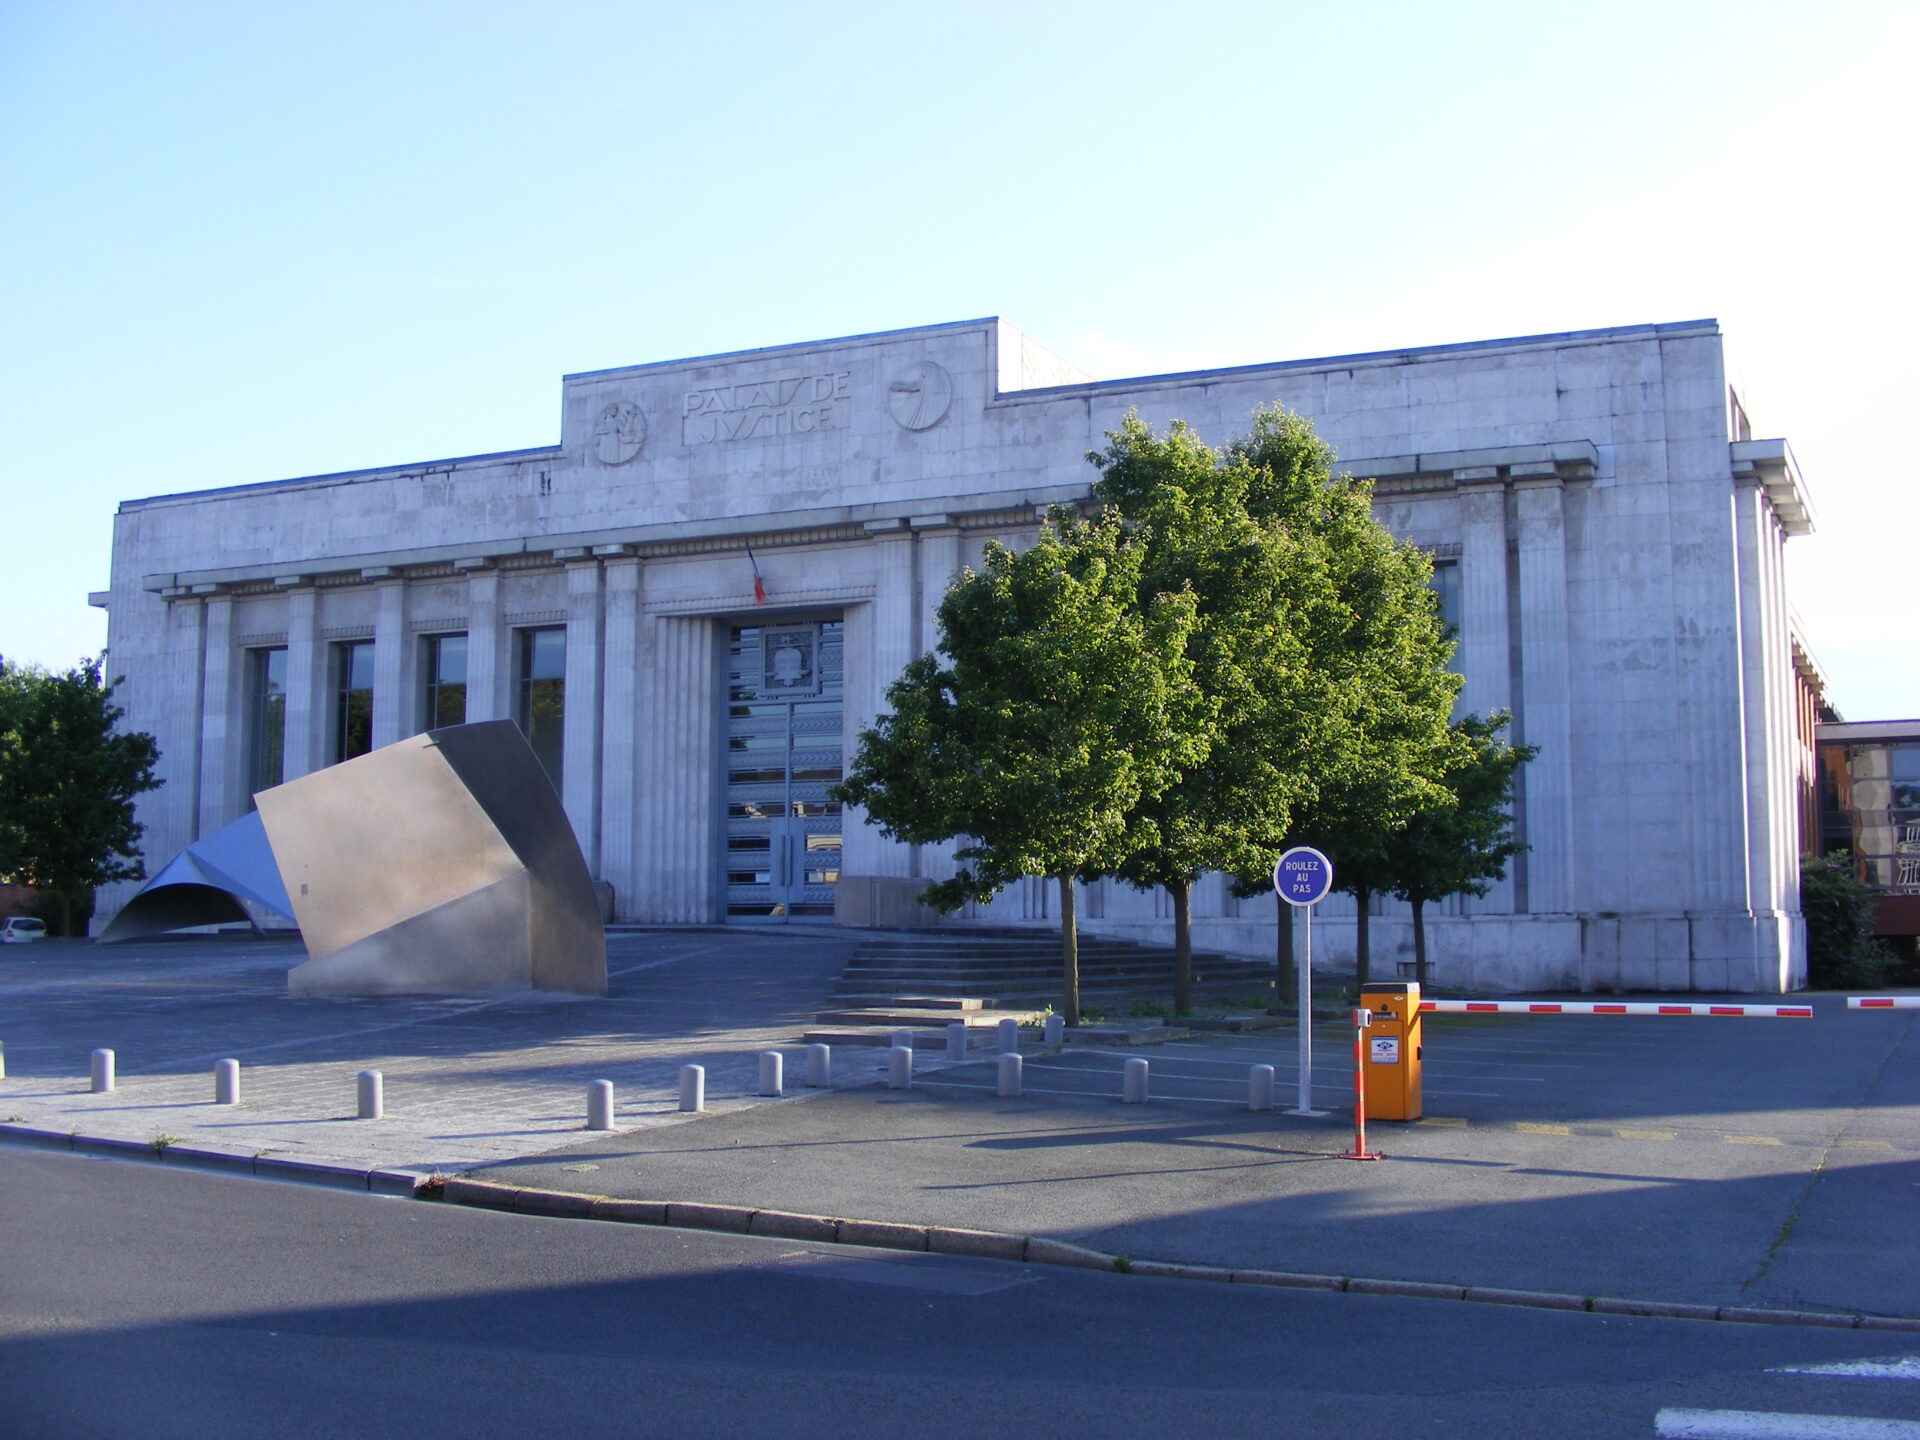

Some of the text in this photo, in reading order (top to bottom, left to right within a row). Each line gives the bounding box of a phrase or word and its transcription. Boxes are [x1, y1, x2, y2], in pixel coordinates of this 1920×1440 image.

[682, 371, 852, 418] PALAIS DE
[1285, 861, 1319, 871] ROULEZ
[1296, 872, 1309, 882] AU
[1292, 884, 1311, 894] PAS
